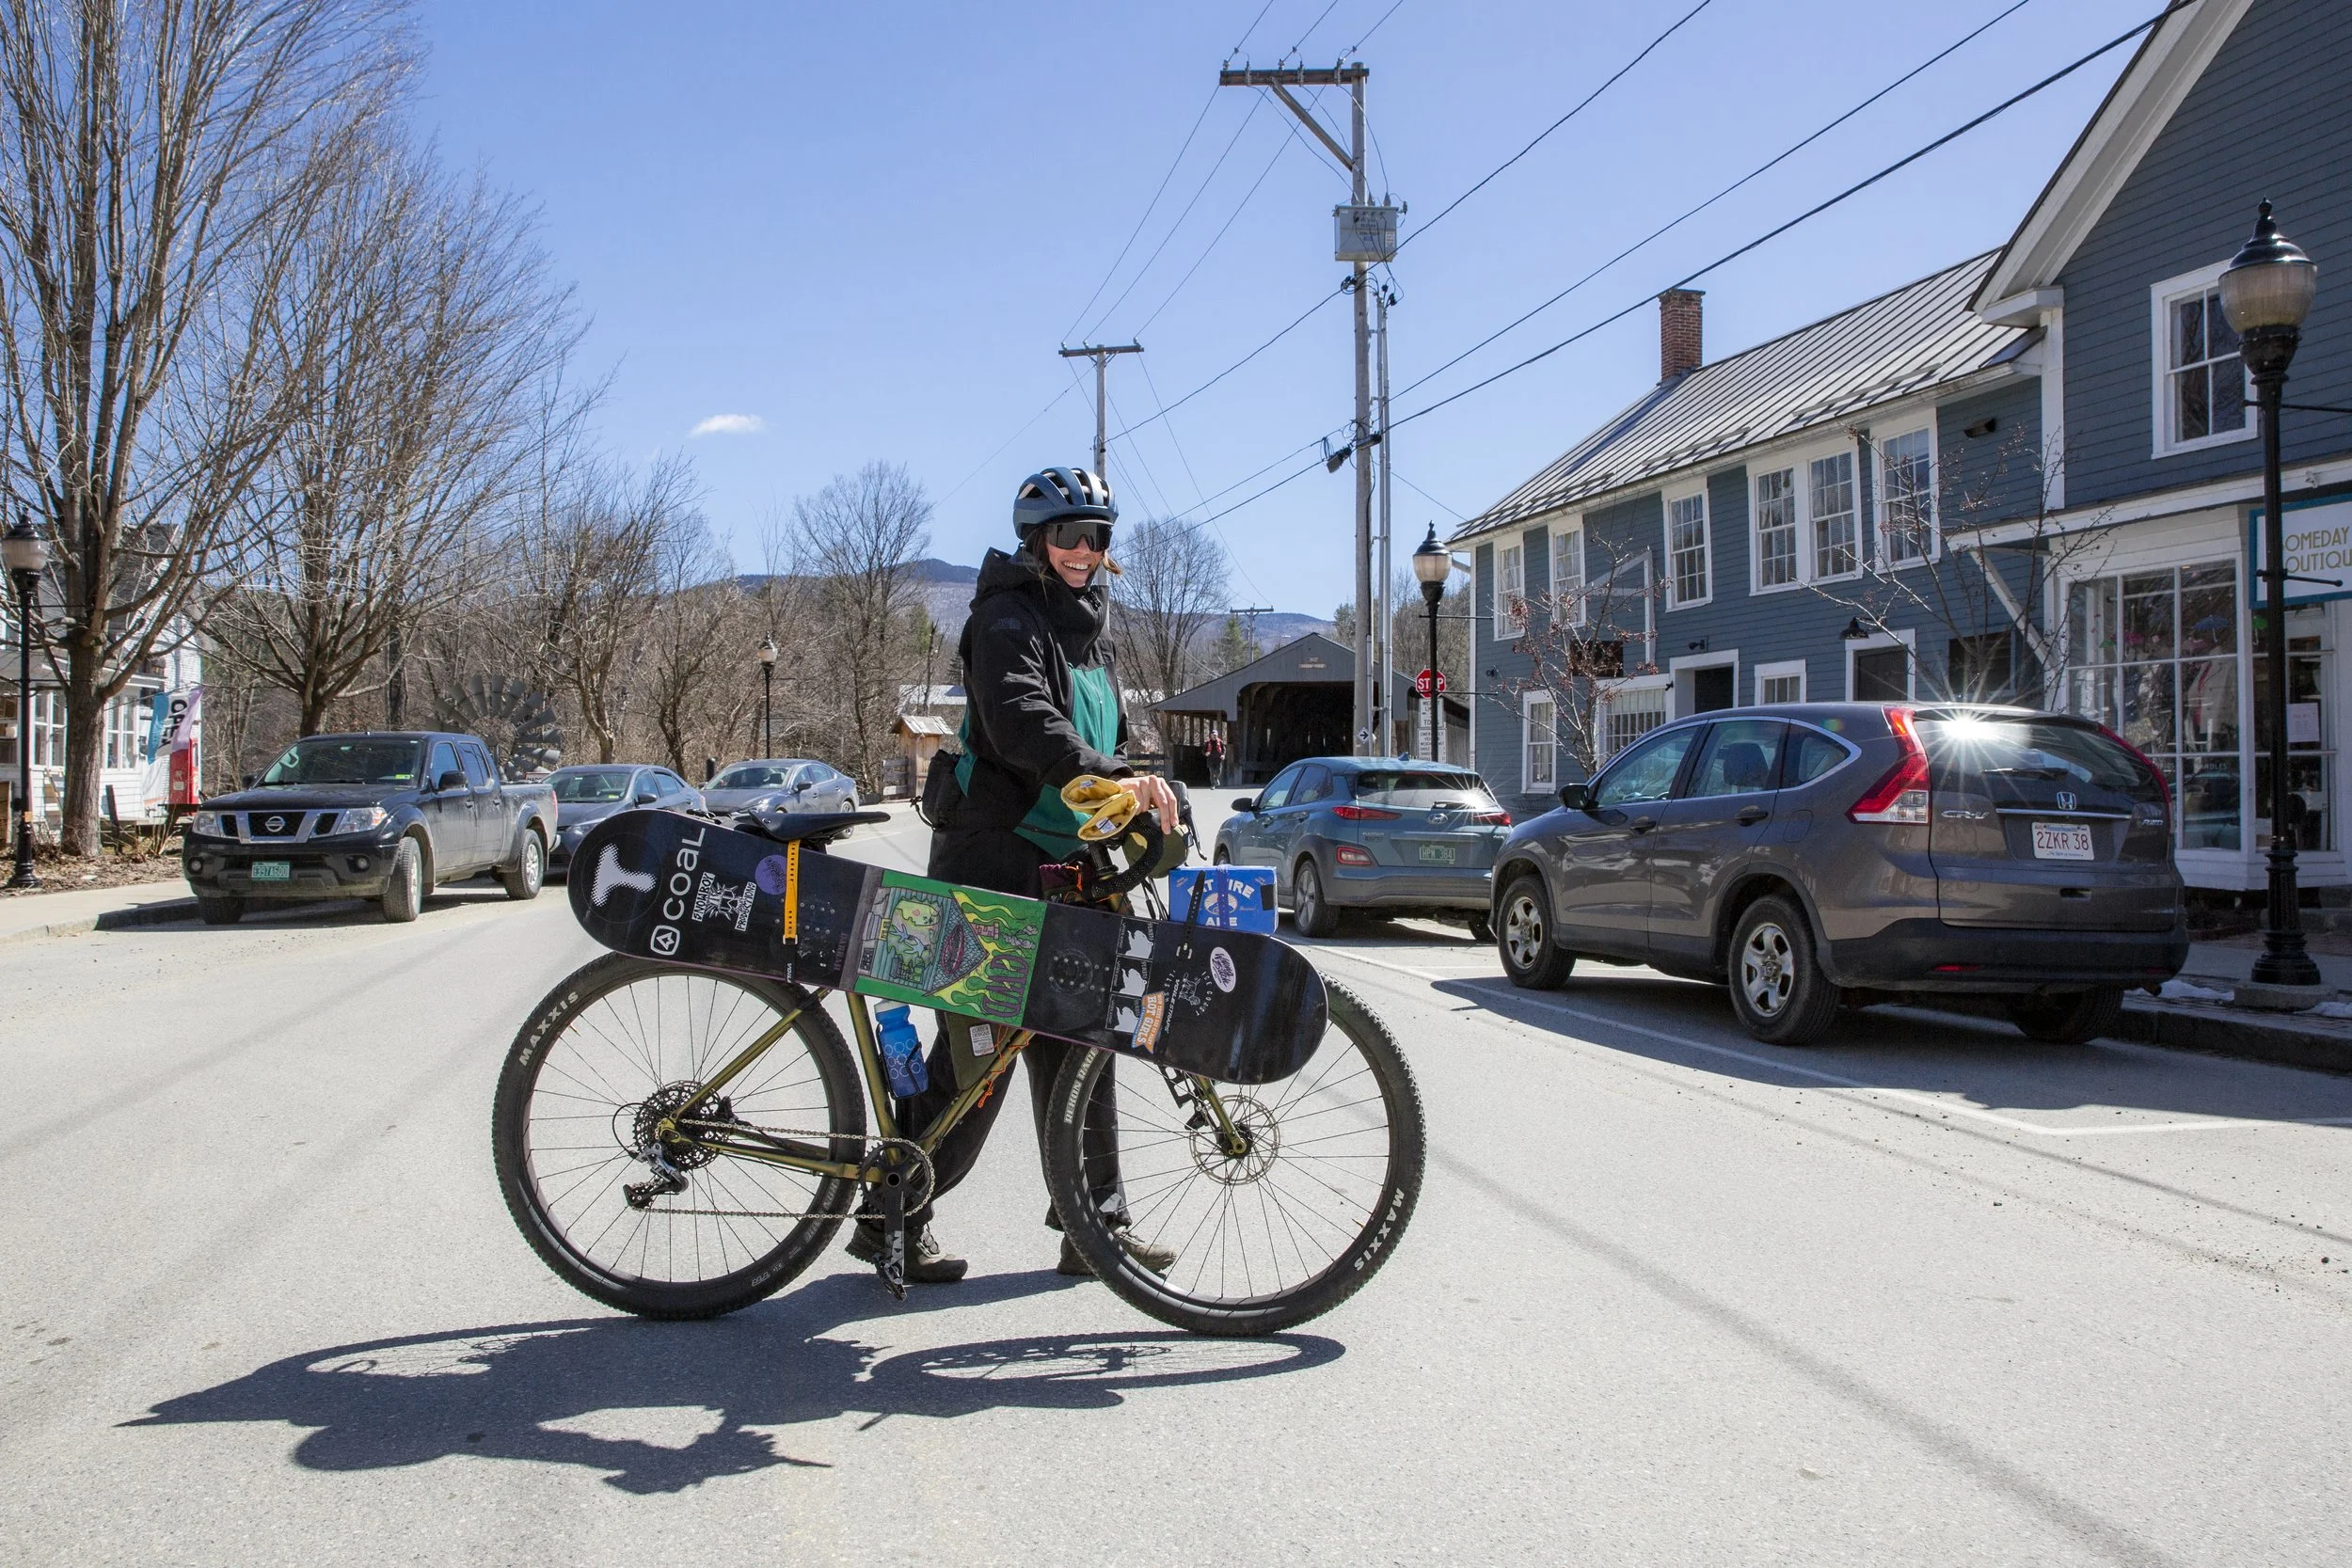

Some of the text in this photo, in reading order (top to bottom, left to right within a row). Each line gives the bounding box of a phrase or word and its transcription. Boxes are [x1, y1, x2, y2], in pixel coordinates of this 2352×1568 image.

[2285, 527, 2349, 552] OMEDAY
[2285, 547, 2352, 574] OUTIQU
[1418, 678, 1444, 689] STP
[2036, 832, 2090, 850] 2ZKR 38
[693, 872, 715, 920] SNOWBOY
[1227, 879, 1255, 899] IRE
[1147, 996, 1156, 1016] HOT
[519, 991, 579, 1067] MAXXIS
[1136, 1017, 1153, 1043] GIRLS
[1354, 1187, 1405, 1271] MAXXIS
